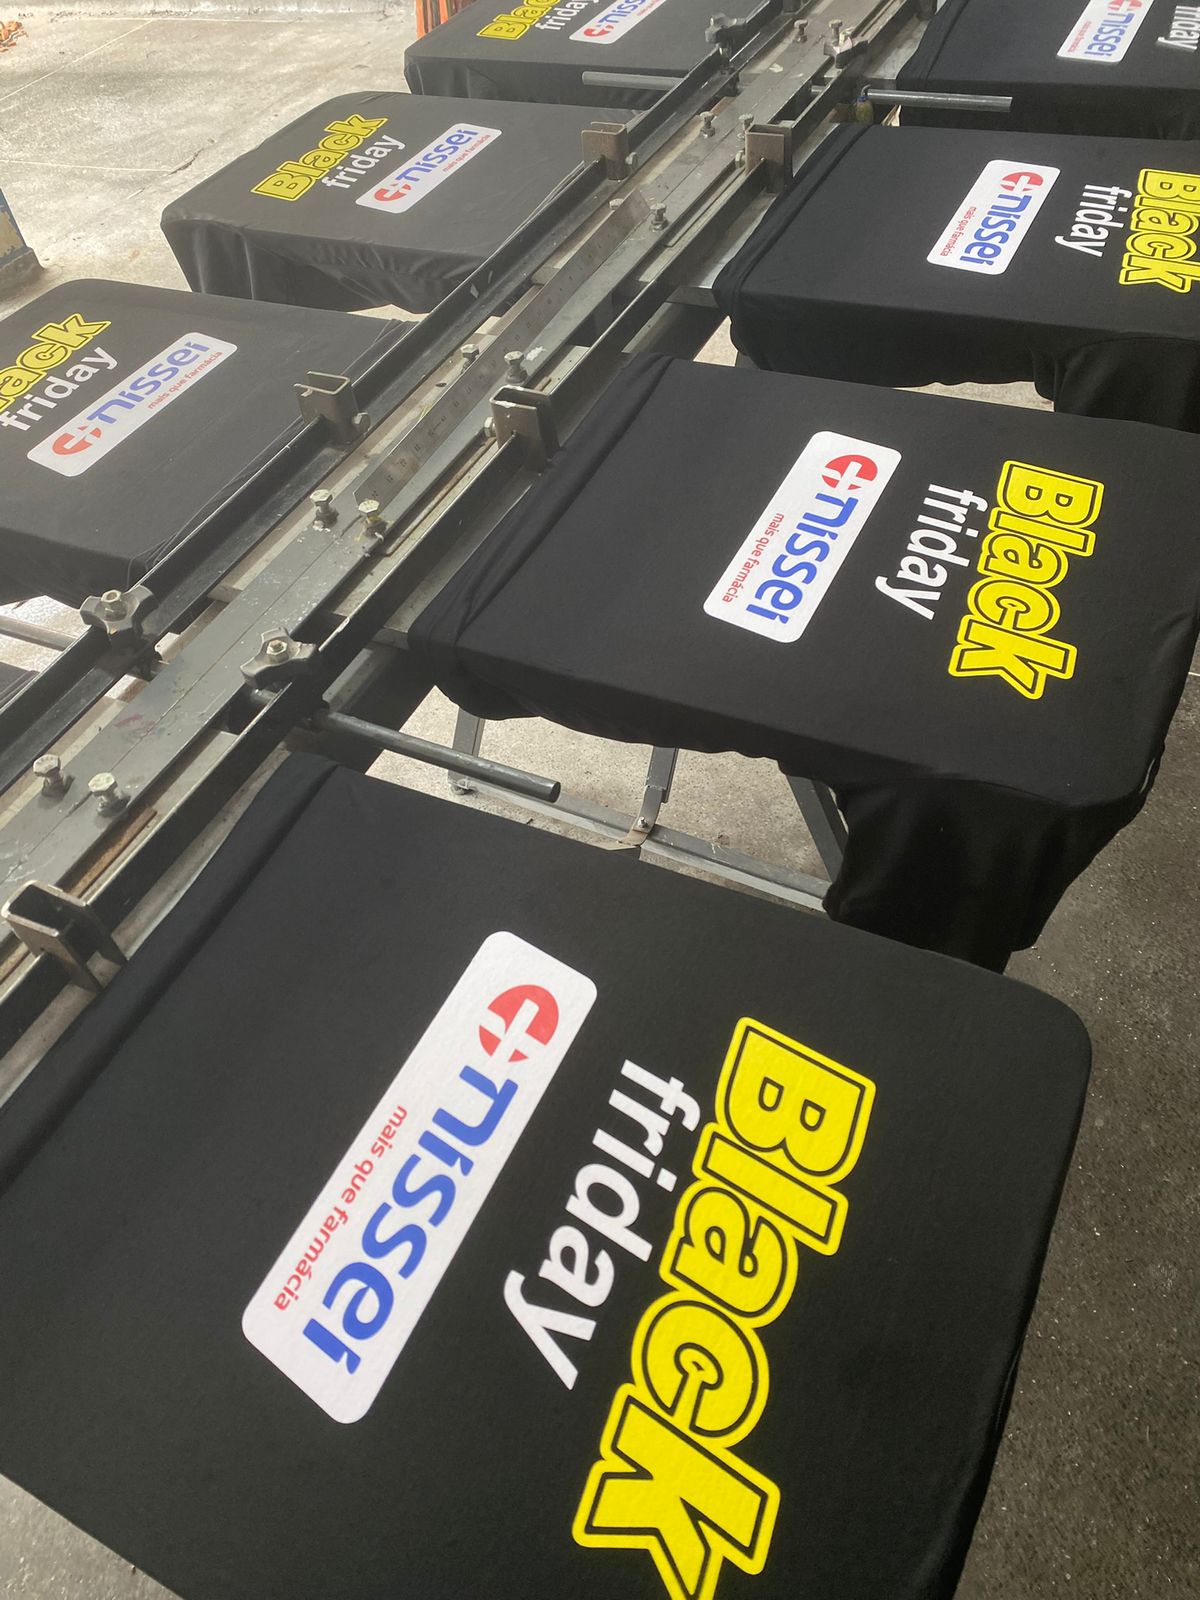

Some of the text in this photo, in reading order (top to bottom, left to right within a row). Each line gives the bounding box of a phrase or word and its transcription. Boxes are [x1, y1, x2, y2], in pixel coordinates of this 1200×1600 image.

[1084, 12, 1135, 56] nissei
[252, 113, 388, 202] Black
[321, 135, 406, 189] friday
[395, 129, 479, 182] nissei
[959, 193, 1032, 266] nissei
[1054, 184, 1132, 257] friday
[1, 346, 118, 431] friday
[86, 341, 210, 425] nissei
[722, 512, 785, 603] mais que farmácia
[746, 493, 858, 624] nissei
[874, 484, 988, 620] friday
[948, 460, 1105, 700] Black
[273, 1105, 408, 1311] mais que farmácia
[302, 1065, 519, 1375] nissei
[503, 1058, 701, 1390] friday
[571, 1017, 877, 1600] Black
